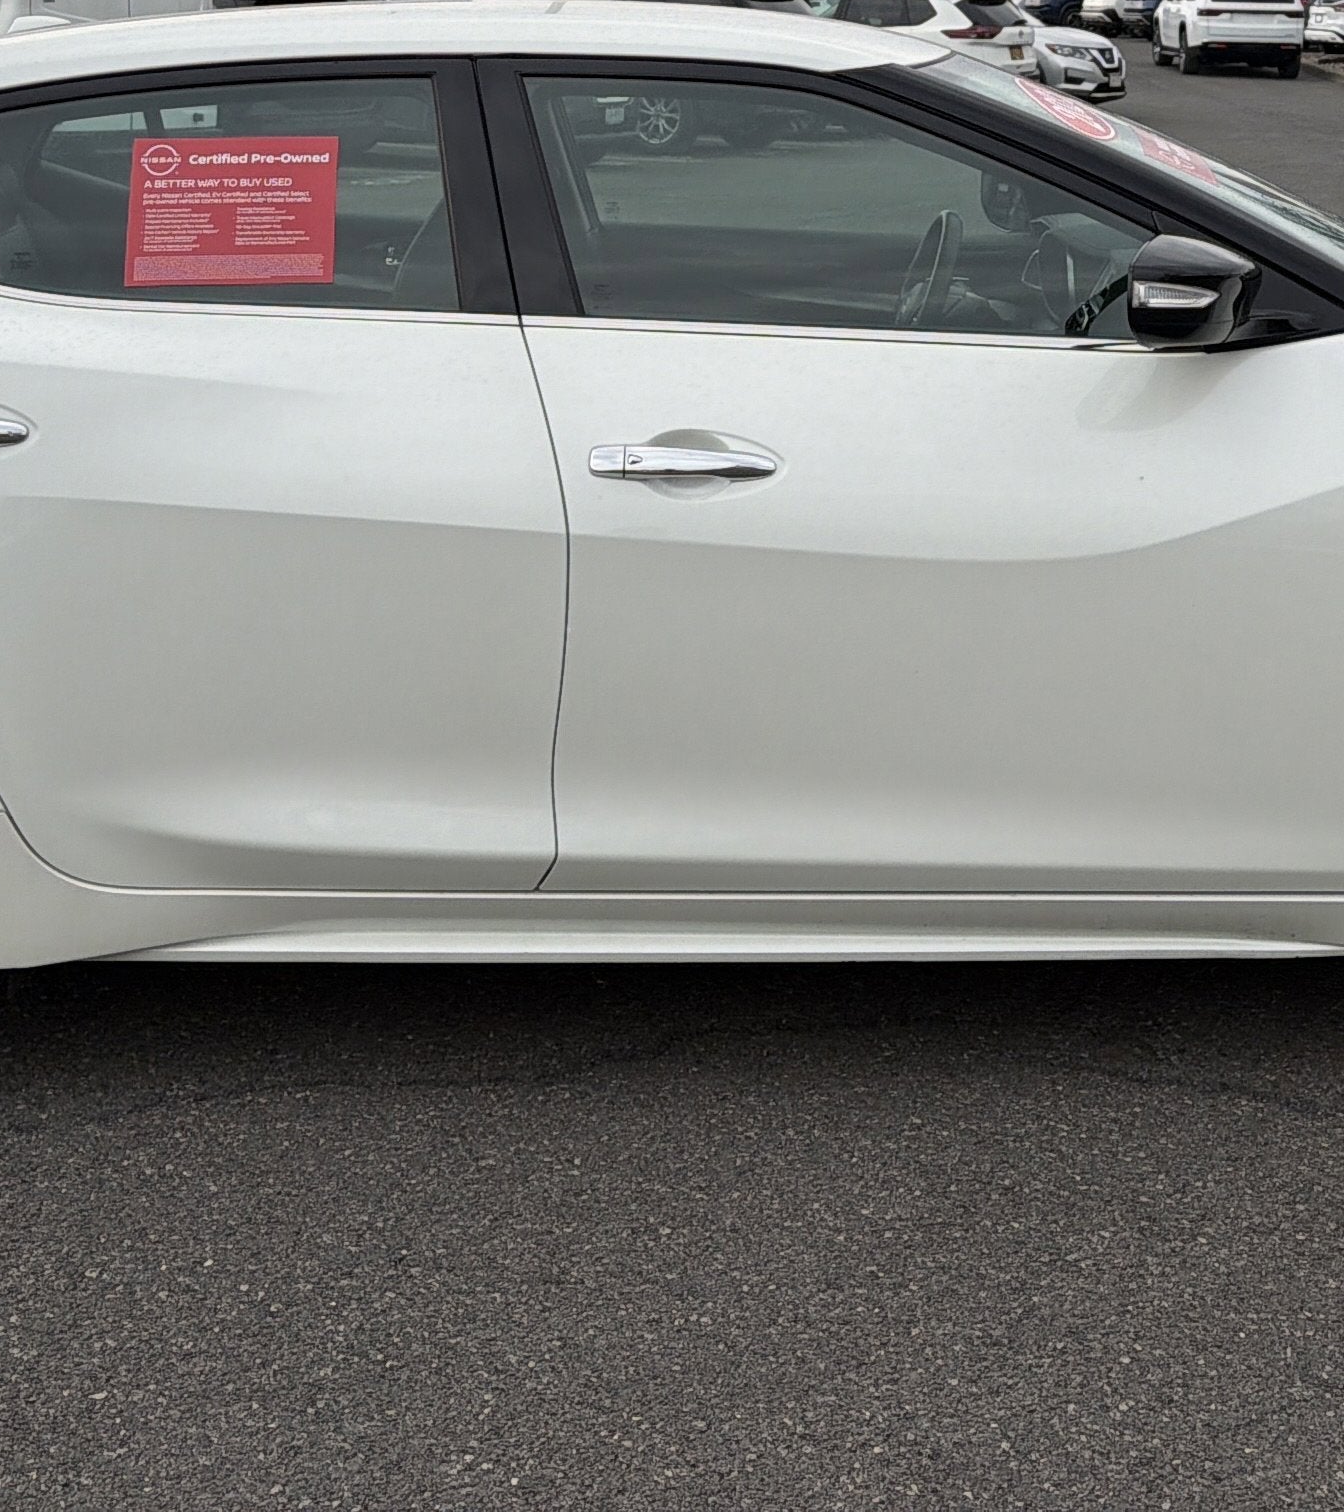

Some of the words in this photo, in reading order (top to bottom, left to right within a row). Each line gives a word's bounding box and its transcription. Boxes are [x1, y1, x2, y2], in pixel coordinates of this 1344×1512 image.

[188, 153, 249, 166] Certified
[250, 152, 330, 165] Pre-Owned
[144, 181, 153, 189] A
[154, 179, 195, 188] BETTER
[196, 178, 220, 188] WAY
[222, 178, 238, 187] TO
[240, 178, 263, 187] BUY
[263, 177, 293, 186] USED
